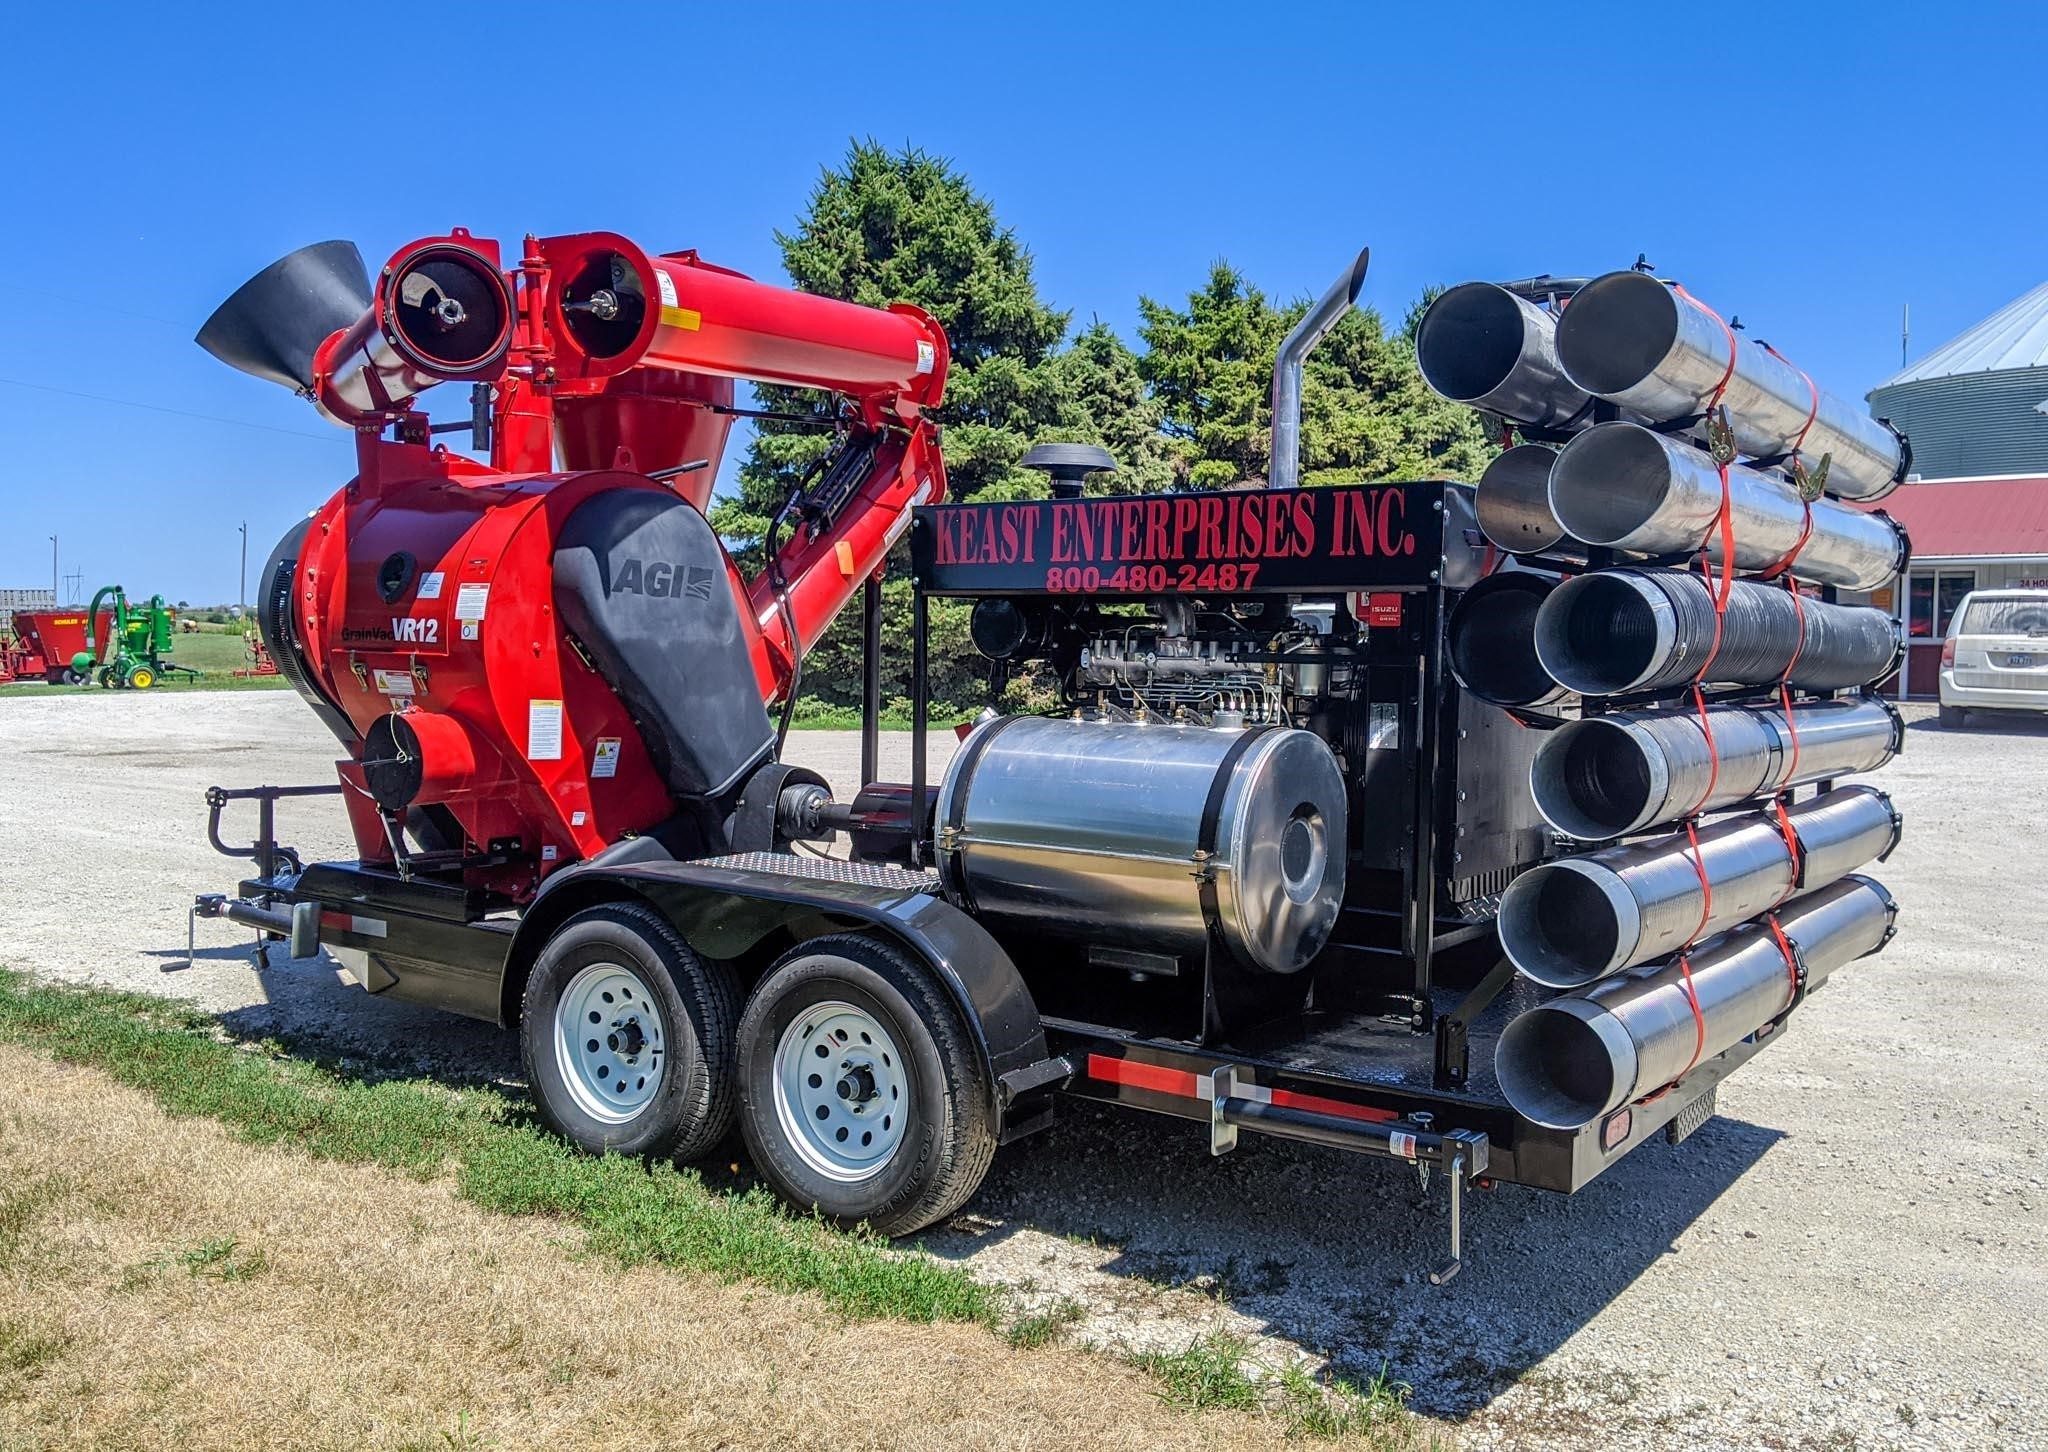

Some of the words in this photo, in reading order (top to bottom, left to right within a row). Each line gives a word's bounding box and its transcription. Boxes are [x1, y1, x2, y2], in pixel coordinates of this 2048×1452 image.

[935, 504, 1041, 565] KEAST
[1050, 491, 1315, 563] ENTERPRISES
[1329, 486, 1416, 557] INC.
[611, 558, 686, 599] AGI
[1046, 563, 1261, 593] 800-480-2487
[342, 627, 393, 641] GrainVac
[392, 617, 438, 643] VR12
